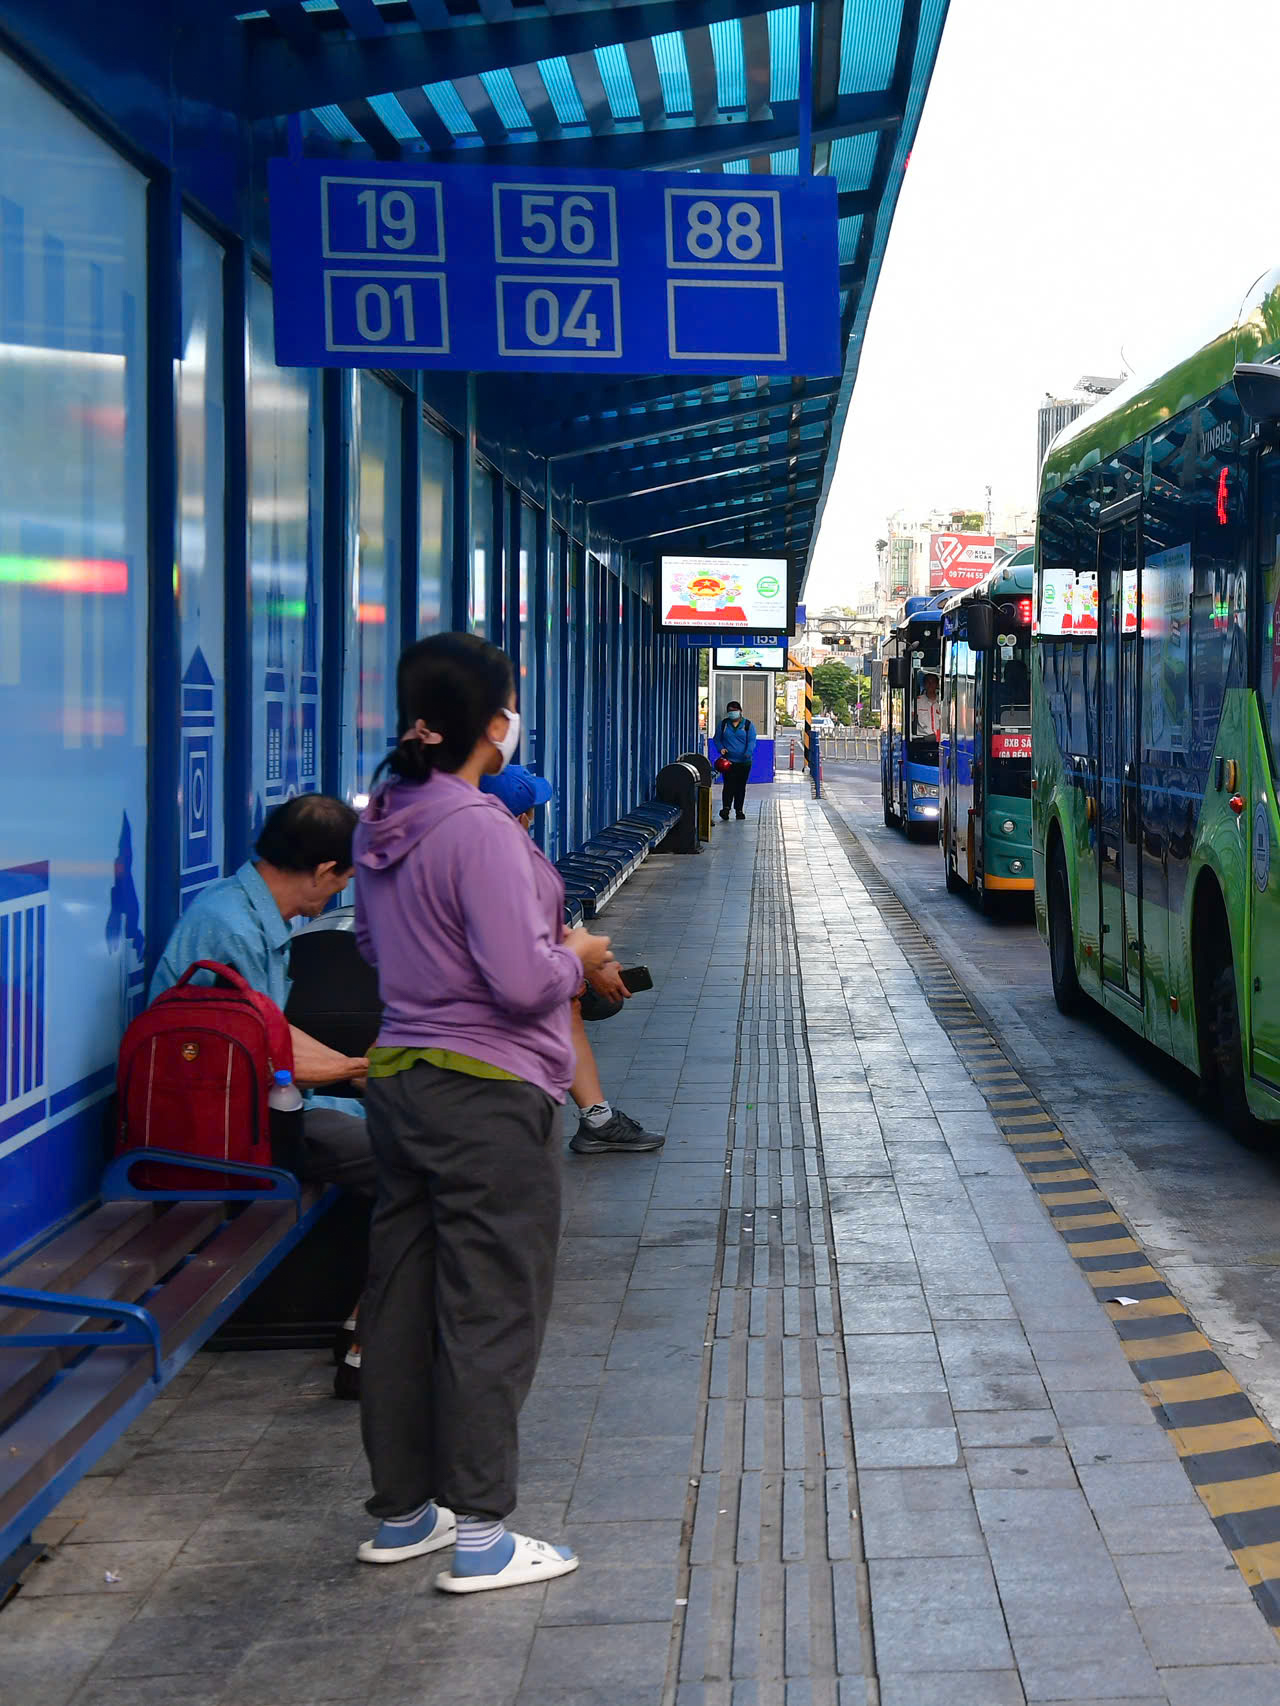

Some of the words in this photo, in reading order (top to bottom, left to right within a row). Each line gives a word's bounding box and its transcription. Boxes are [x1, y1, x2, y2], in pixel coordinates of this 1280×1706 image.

[357, 189, 416, 250] 19
[521, 194, 595, 255] 56
[686, 200, 762, 261] 88
[355, 283, 415, 342] 01
[525, 288, 601, 348] 04
[1202, 420, 1232, 455] VINBUS
[1004, 738, 1019, 748] BXB
